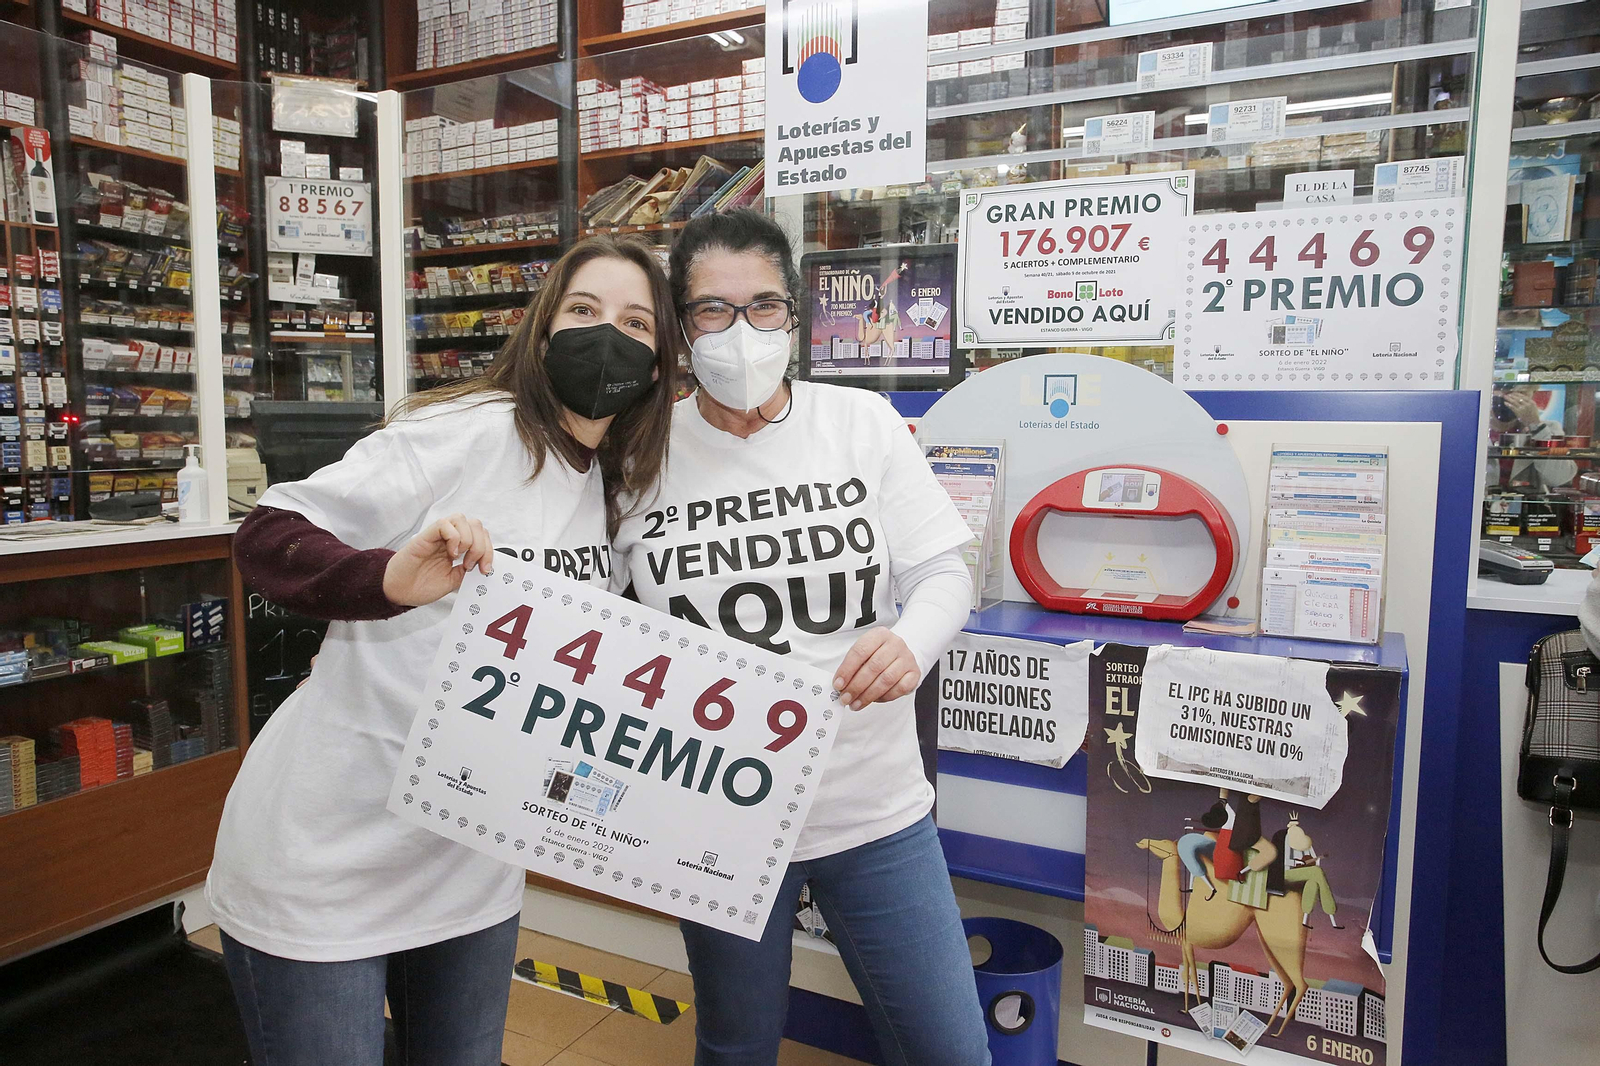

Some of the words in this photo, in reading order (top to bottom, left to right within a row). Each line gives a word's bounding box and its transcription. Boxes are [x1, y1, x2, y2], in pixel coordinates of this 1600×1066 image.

[1162, 52, 1184, 60] 53334
[1234, 106, 1256, 114] 92731
[778, 116, 861, 140] Loterías
[867, 116, 880, 134] y
[1106, 119, 1128, 127] 56224
[778, 139, 874, 165] Apuestas
[878, 131, 912, 151] del
[777, 164, 847, 186] Estado
[1403, 165, 1430, 173] 87745
[301, 184, 354, 198] PREMIO
[1296, 184, 1310, 192] EL
[1314, 182, 1328, 190] DE
[1332, 182, 1348, 190] LA
[987, 200, 1054, 224] GRAN
[1065, 193, 1161, 217] PREMIO
[1306, 195, 1336, 204] CASA
[1000, 223, 1133, 257] 176.907
[1138, 237, 1150, 251] €
[1010, 260, 1049, 270] ACIERTOS
[1058, 255, 1140, 266] COMPLEMENTARIO
[819, 277, 830, 291] EL
[911, 288, 916, 297] 6
[918, 287, 941, 297] ENERO
[1047, 290, 1073, 299] Bono
[1099, 288, 1124, 297] Loto
[1243, 272, 1424, 312] PREMIO
[989, 306, 1084, 325] VENDIDO
[1092, 299, 1151, 323] AQUÍ
[1055, 421, 1068, 429] del
[1070, 421, 1100, 430] Estado
[641, 505, 680, 540] 2º
[687, 477, 868, 531] PREMIO
[647, 517, 876, 585] VENDIDO
[947, 650, 967, 672] 17
[973, 649, 1020, 677] AÑOS
[1027, 657, 1050, 681] DE
[1106, 662, 1139, 673] SORTEO
[942, 678, 1052, 712] COMISIONES
[1105, 686, 1135, 717] EL
[1169, 682, 1184, 700] EL
[1188, 686, 1210, 703] IPC
[1214, 690, 1232, 707] HA
[1236, 693, 1287, 716] SUBIDO
[1292, 703, 1311, 720] UN
[941, 707, 1056, 743] CONGELADAS
[1181, 705, 1216, 726] 31%,
[1220, 712, 1293, 737] NUESTRAS
[521, 683, 773, 807] PREMIO
[1170, 724, 1252, 751] COMISIONES
[1257, 738, 1276, 756] UN
[1280, 743, 1304, 762] 0%
[1210, 766, 1228, 774] LOTEROS
[438, 771, 458, 783] Loterías
[462, 782, 487, 795] Apuestas
[456, 786, 474, 796] Estado
[521, 801, 569, 824] SORTEO
[571, 818, 587, 830] DE
[591, 822, 607, 837] "EL
[610, 830, 650, 848] NIÑO"
[541, 836, 566, 849] Estanco
[566, 844, 588, 856] Guerra
[592, 852, 609, 862] VIGO
[546, 826, 552, 834] 6
[554, 828, 565, 838] de
[567, 834, 590, 847] enero
[592, 840, 615, 855] 2022
[677, 858, 703, 872] Lotería
[703, 866, 735, 881] Nacional
[1113, 1000, 1155, 1015] NACIONAL
[1114, 993, 1146, 1006] LOTERÍA
[1118, 1018, 1155, 1032] RESPONSABILIDAD
[1306, 1035, 1317, 1051] 6
[1322, 1038, 1374, 1066] ENERO
